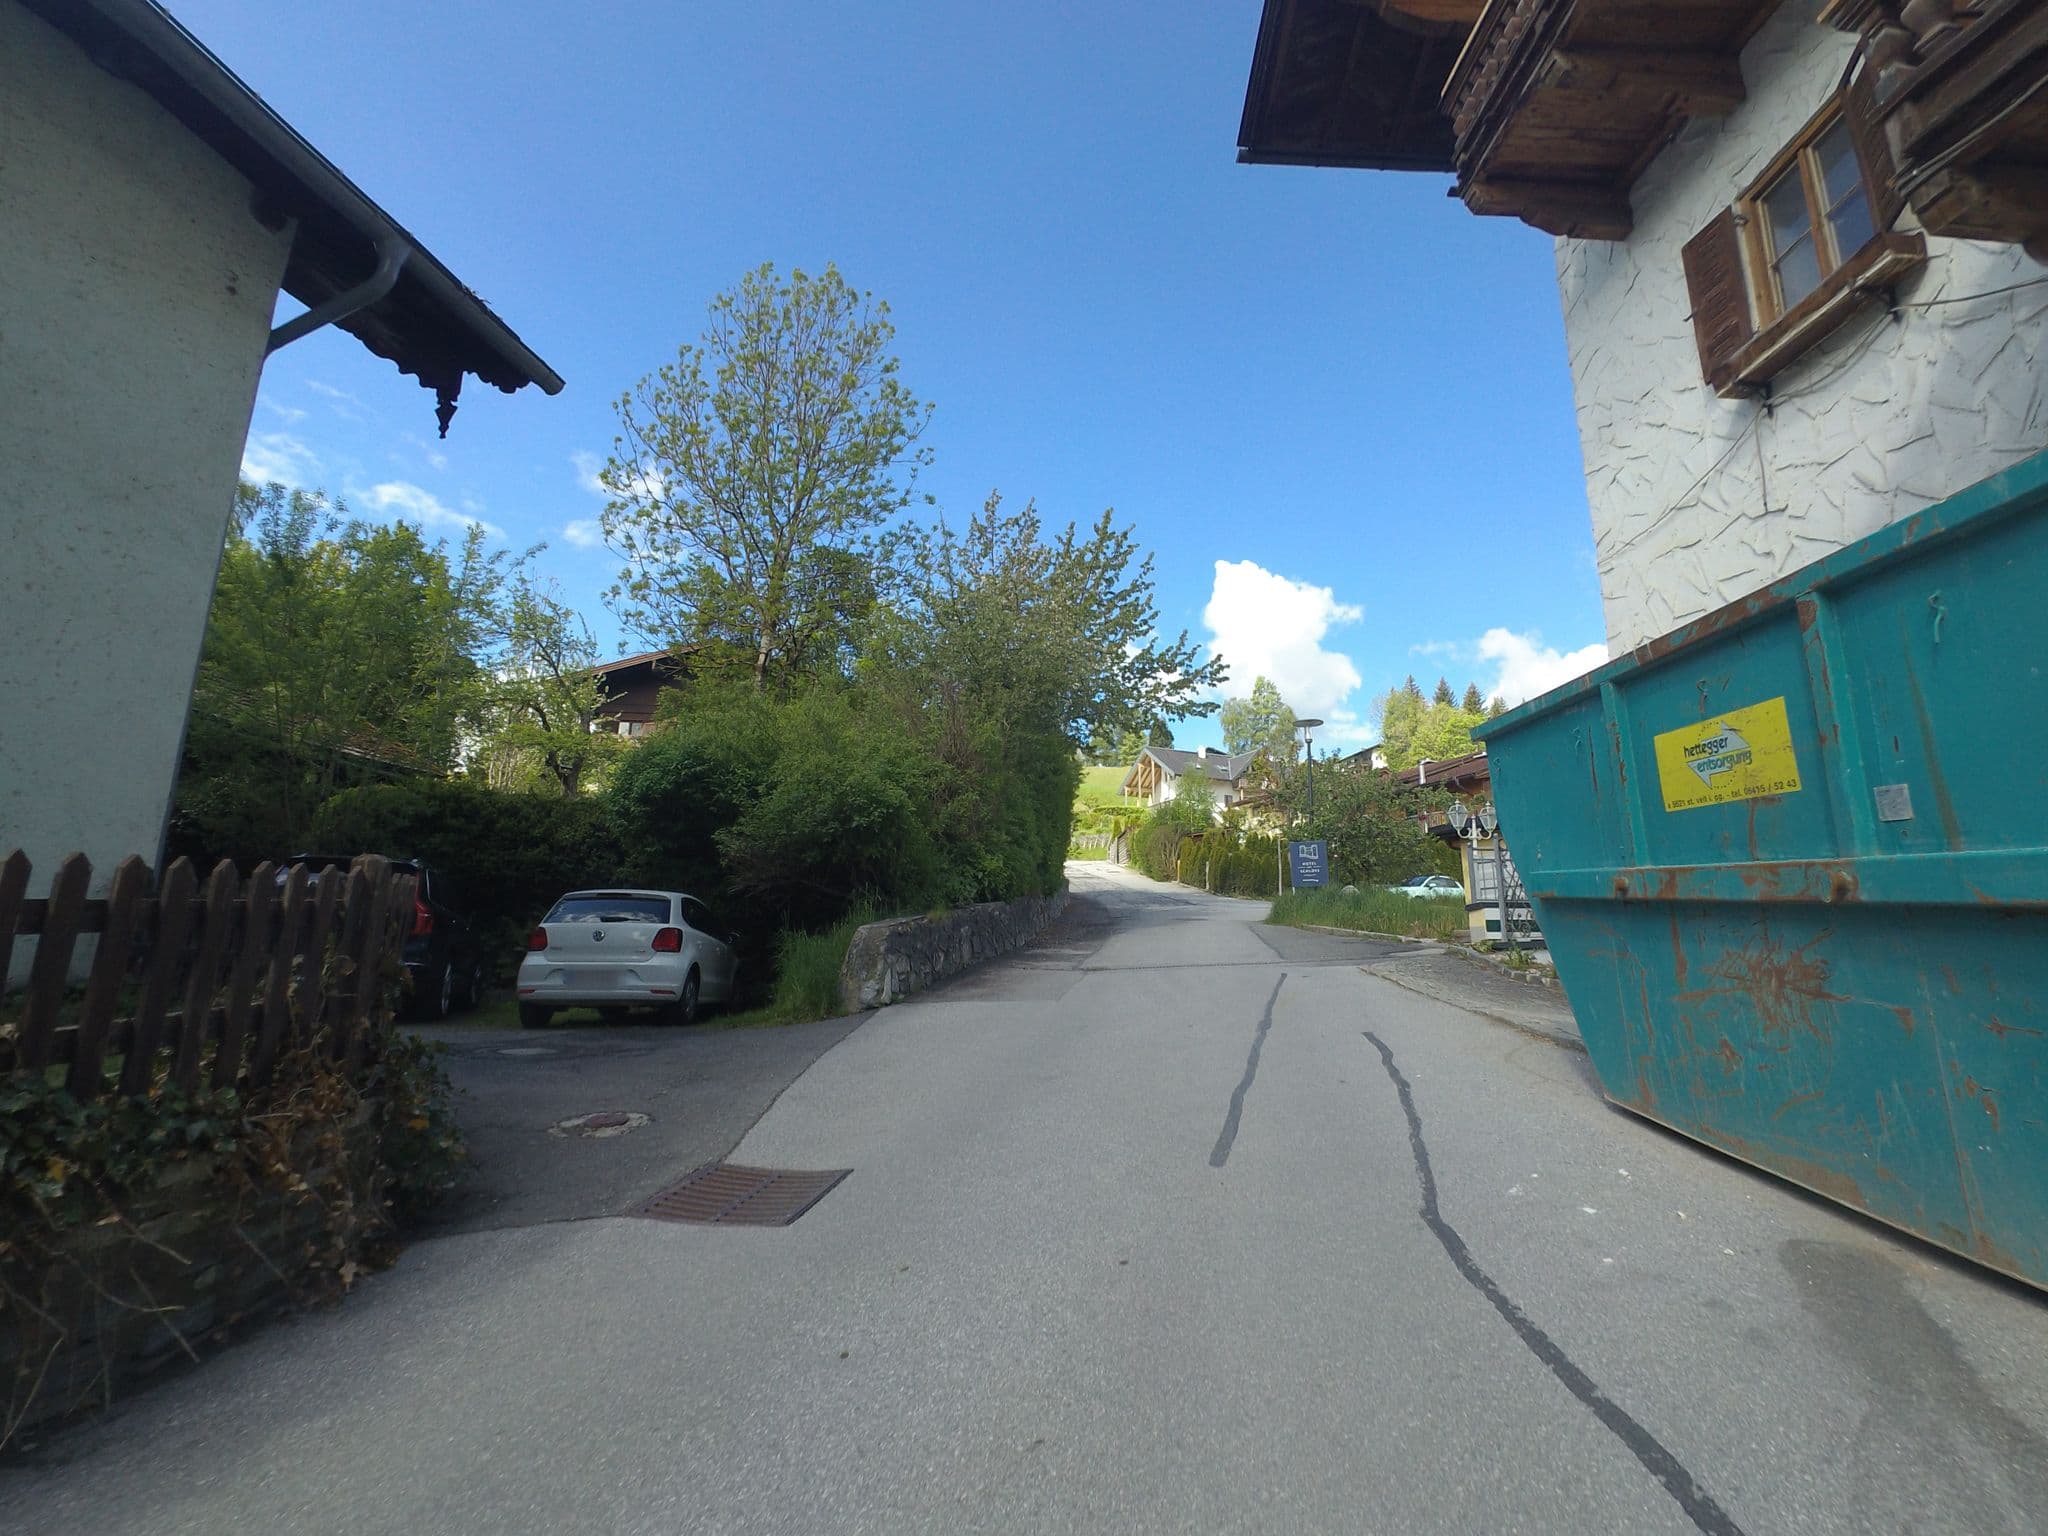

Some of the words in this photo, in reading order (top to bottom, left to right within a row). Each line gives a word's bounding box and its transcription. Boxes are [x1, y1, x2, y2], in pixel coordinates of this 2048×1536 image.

[1683, 737, 1729, 758] hettegger
[1696, 750, 1753, 773] entsorgung
[1774, 781, 1784, 791] 52
[1786, 779, 1797, 788] 43
